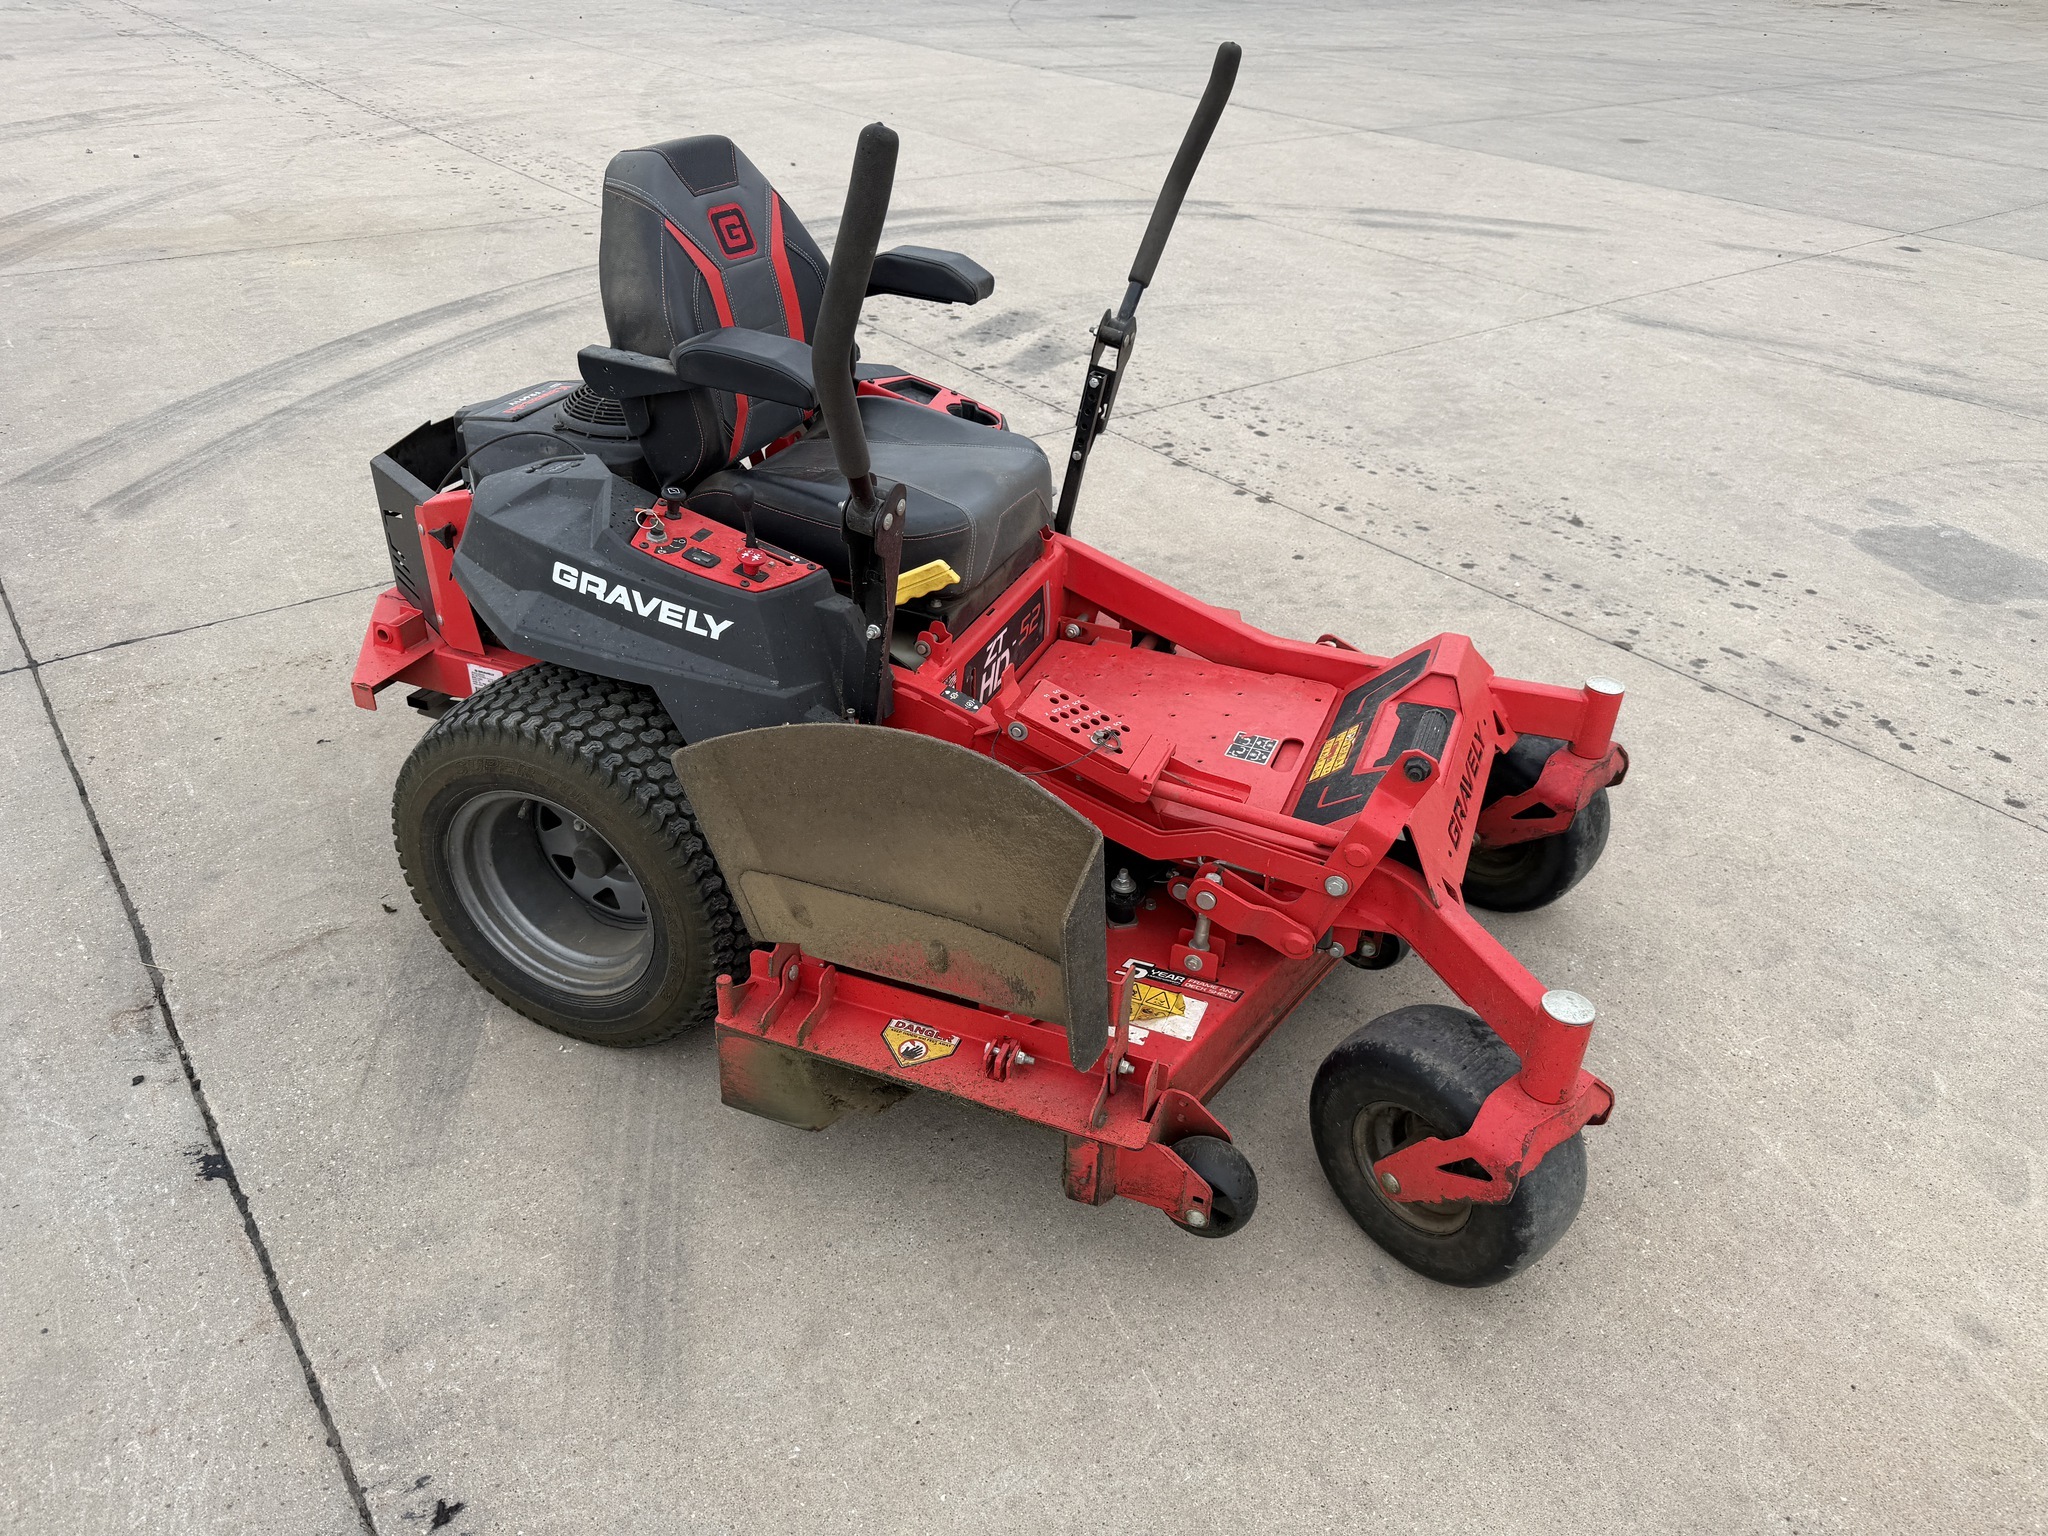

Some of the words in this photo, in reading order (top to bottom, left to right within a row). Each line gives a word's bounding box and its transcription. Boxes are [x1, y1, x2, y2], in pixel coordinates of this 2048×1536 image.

[552, 561, 735, 641] GRAVELY
[984, 627, 1008, 669] ZT
[980, 648, 1010, 703] HD
[455, 757, 536, 779] SUPER
[1448, 721, 1485, 851] GRAVELY
[1151, 969, 1186, 983] YEAR
[1184, 983, 1205, 992] DECK
[1207, 988, 1234, 1000] SHELL
[1188, 978, 1217, 990] FRAME
[1219, 987, 1238, 996] AND
